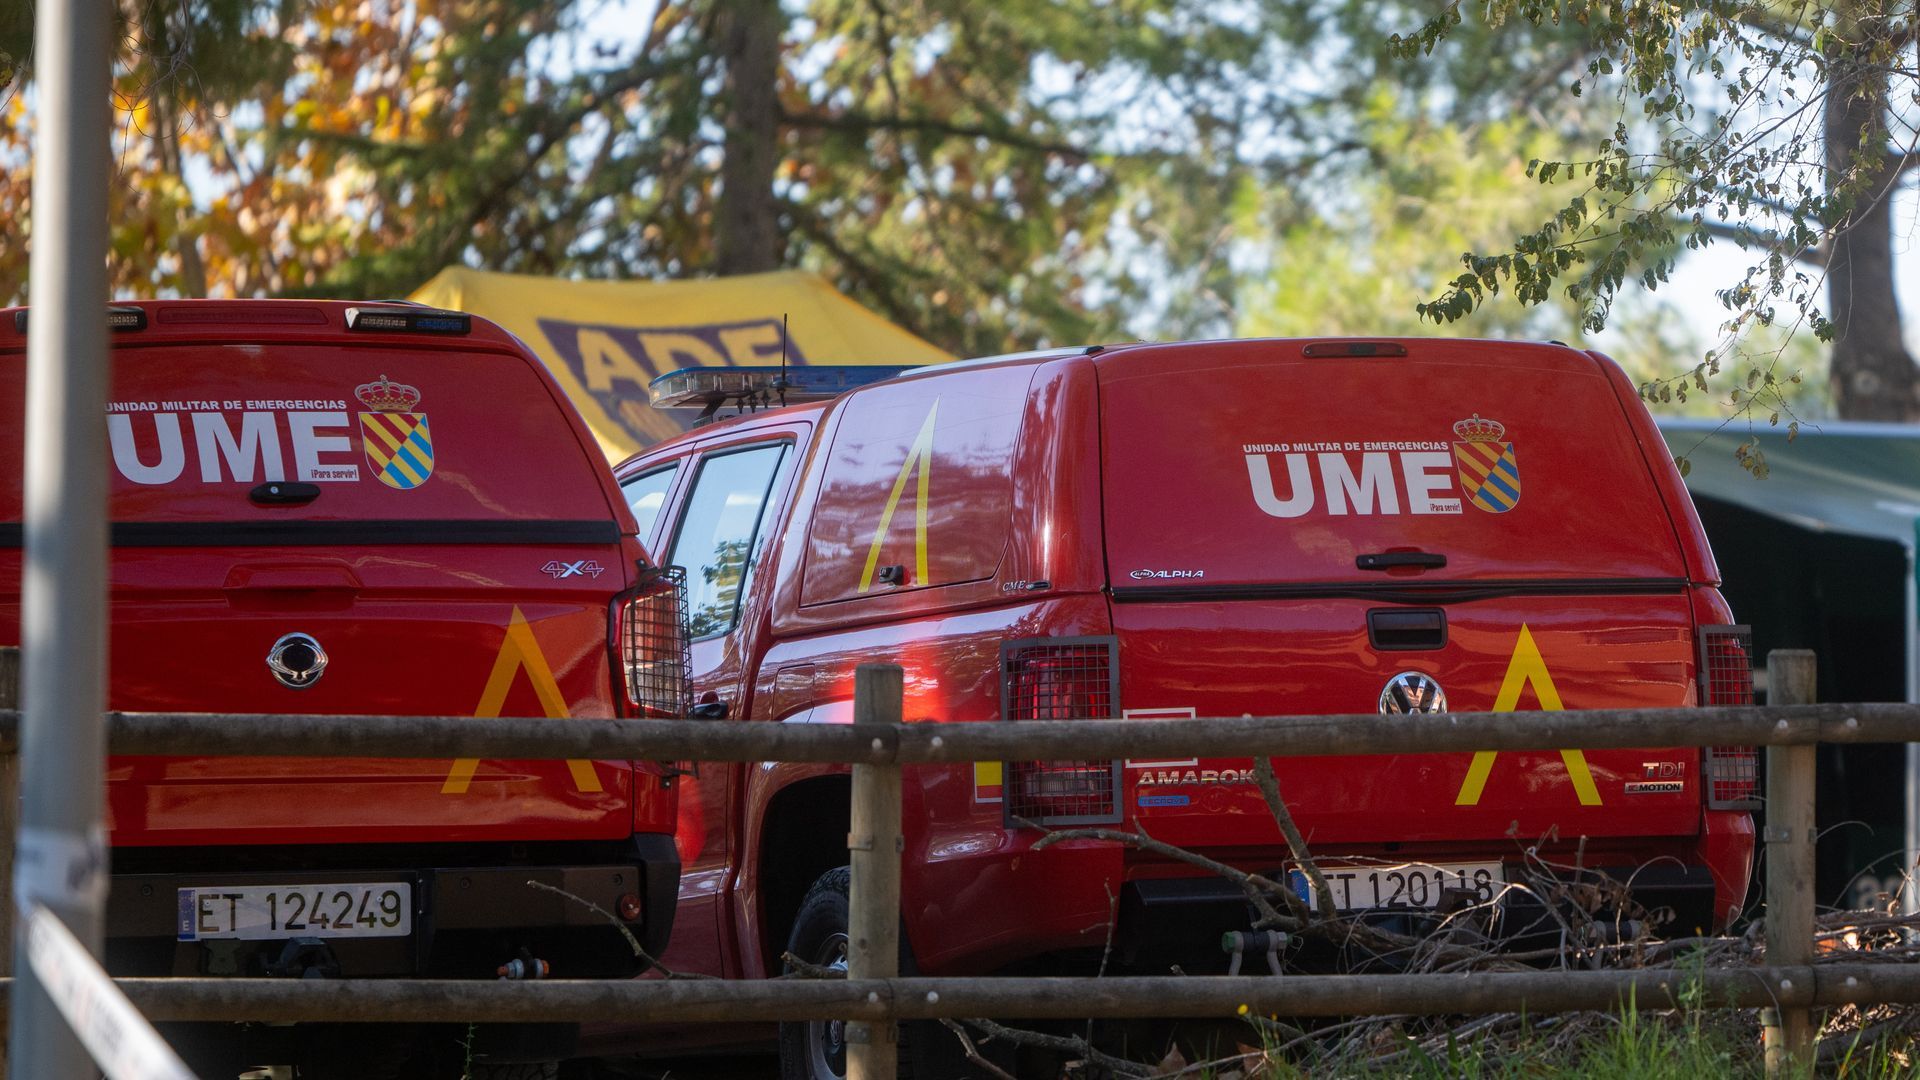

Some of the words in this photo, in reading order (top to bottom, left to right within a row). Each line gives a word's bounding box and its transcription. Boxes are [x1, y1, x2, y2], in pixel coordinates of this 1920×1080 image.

[104, 402, 158, 412] UNIDAD
[162, 401, 219, 411] MILITAR
[223, 400, 242, 410] DE
[246, 400, 347, 410] EMERGENCIAS
[105, 411, 360, 485] UME
[1242, 444, 1290, 453] UNIDAD
[1293, 443, 1341, 452] MILITAR
[1344, 442, 1360, 451] DE
[1363, 441, 1449, 451] EMERGENCIAS
[1245, 452, 1463, 518] UME
[1153, 570, 1204, 578] ALPHA
[1136, 769, 1257, 786] AMAROK
[1642, 761, 1686, 778] TDI
[1368, 868, 1494, 909] 120118
[198, 893, 244, 933] ET
[265, 889, 401, 931] 124249
